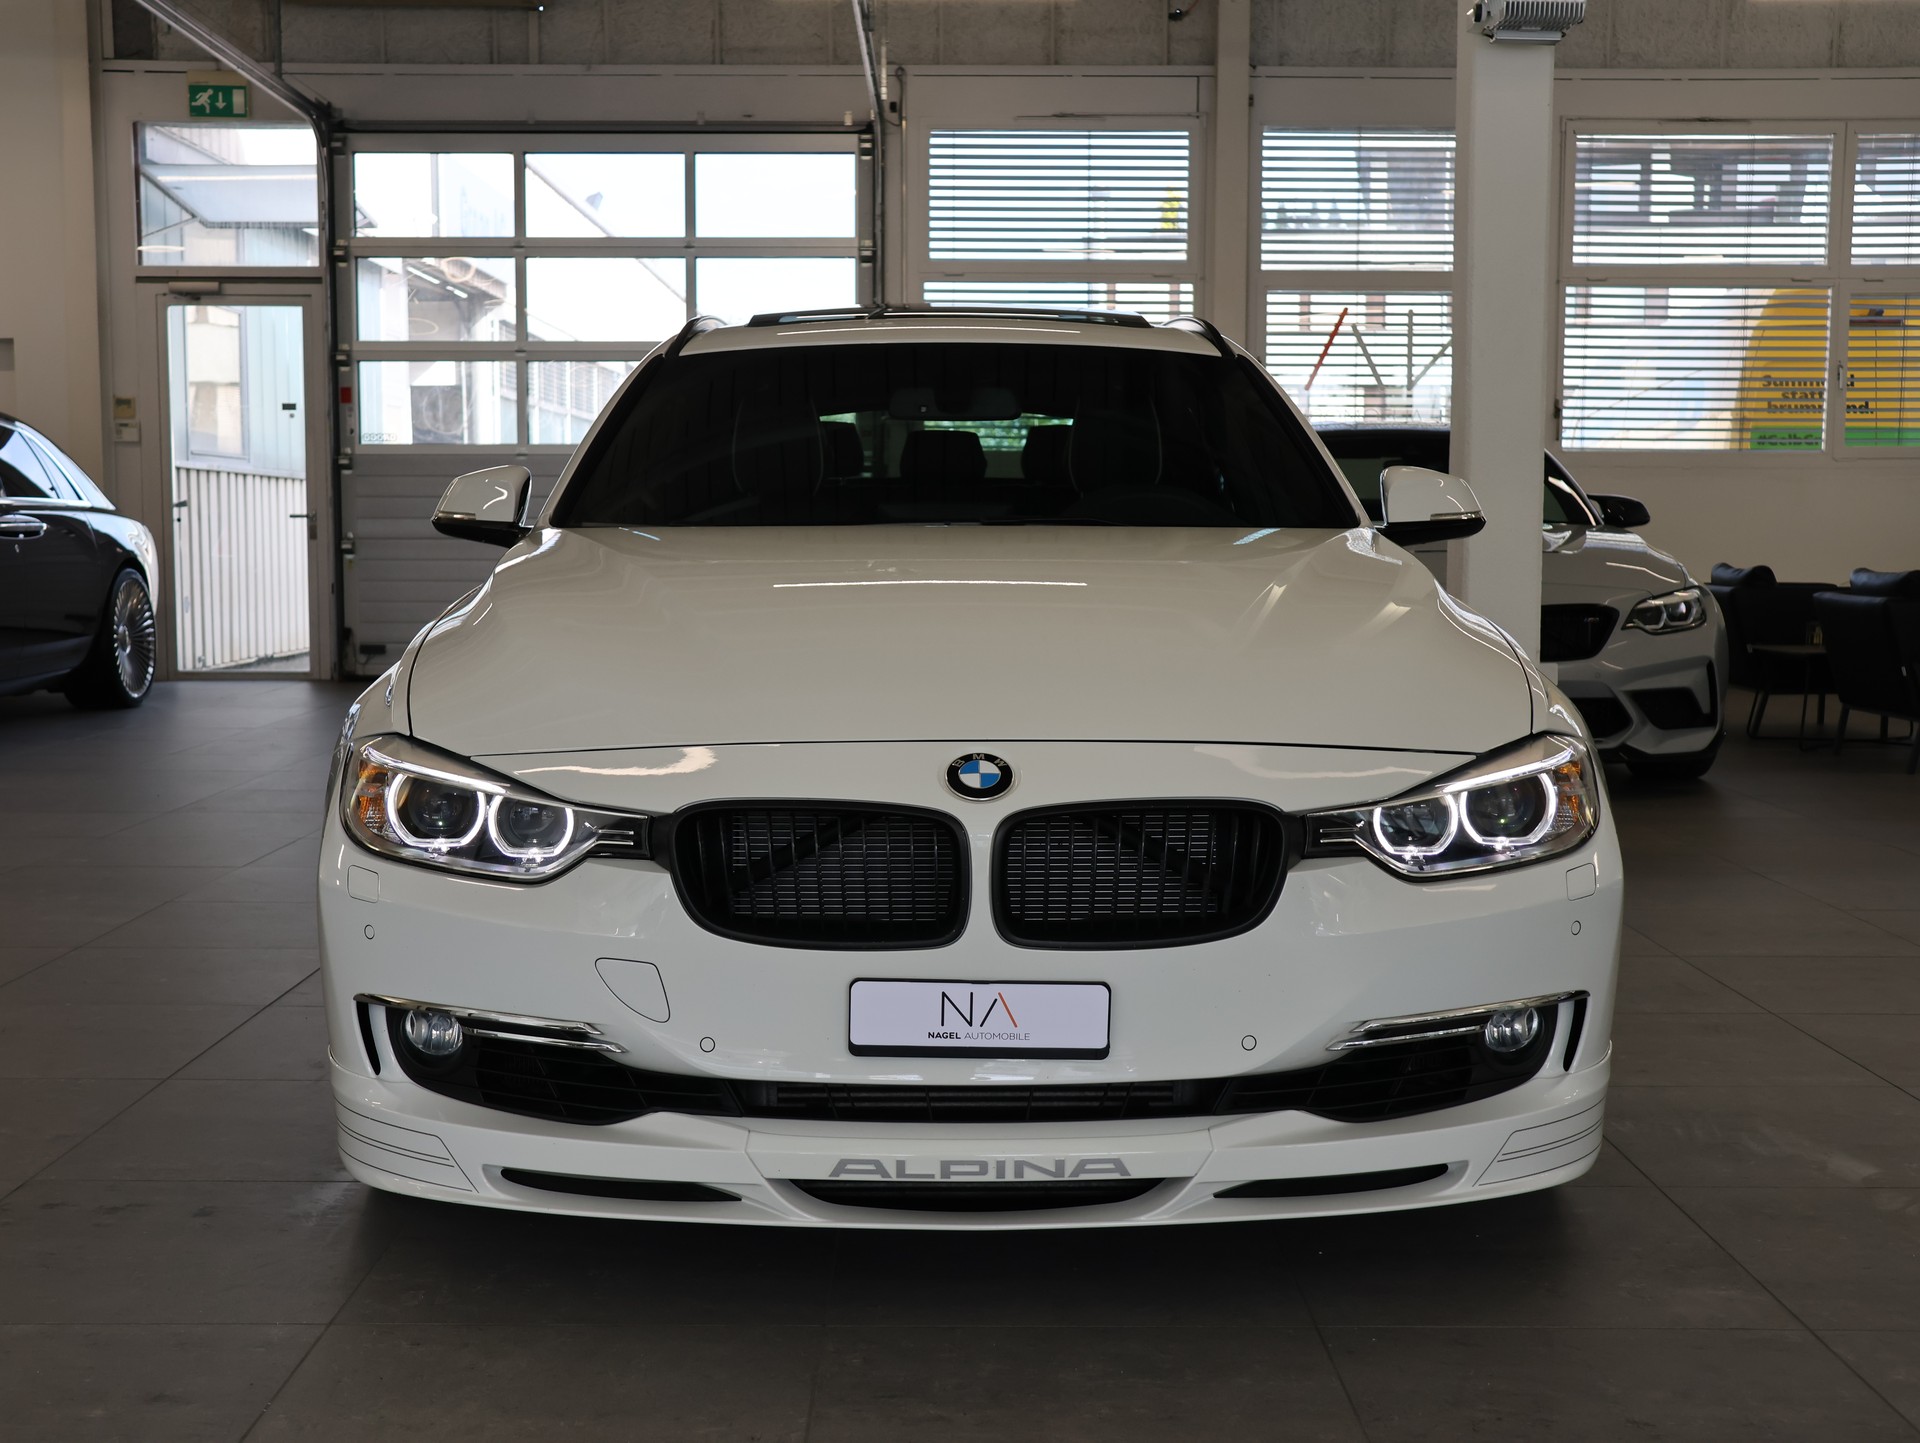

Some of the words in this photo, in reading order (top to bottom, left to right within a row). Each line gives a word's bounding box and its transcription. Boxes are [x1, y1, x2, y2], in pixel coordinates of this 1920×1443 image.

[1762, 374, 1855, 387] Summd
[1767, 400, 1874, 414] brumnd.
[951, 753, 1008, 768] BMW
[927, 1031, 961, 1040] NAGEL
[963, 1032, 1030, 1041] AUTOMOBILE
[828, 1158, 1132, 1179] ALPINA
